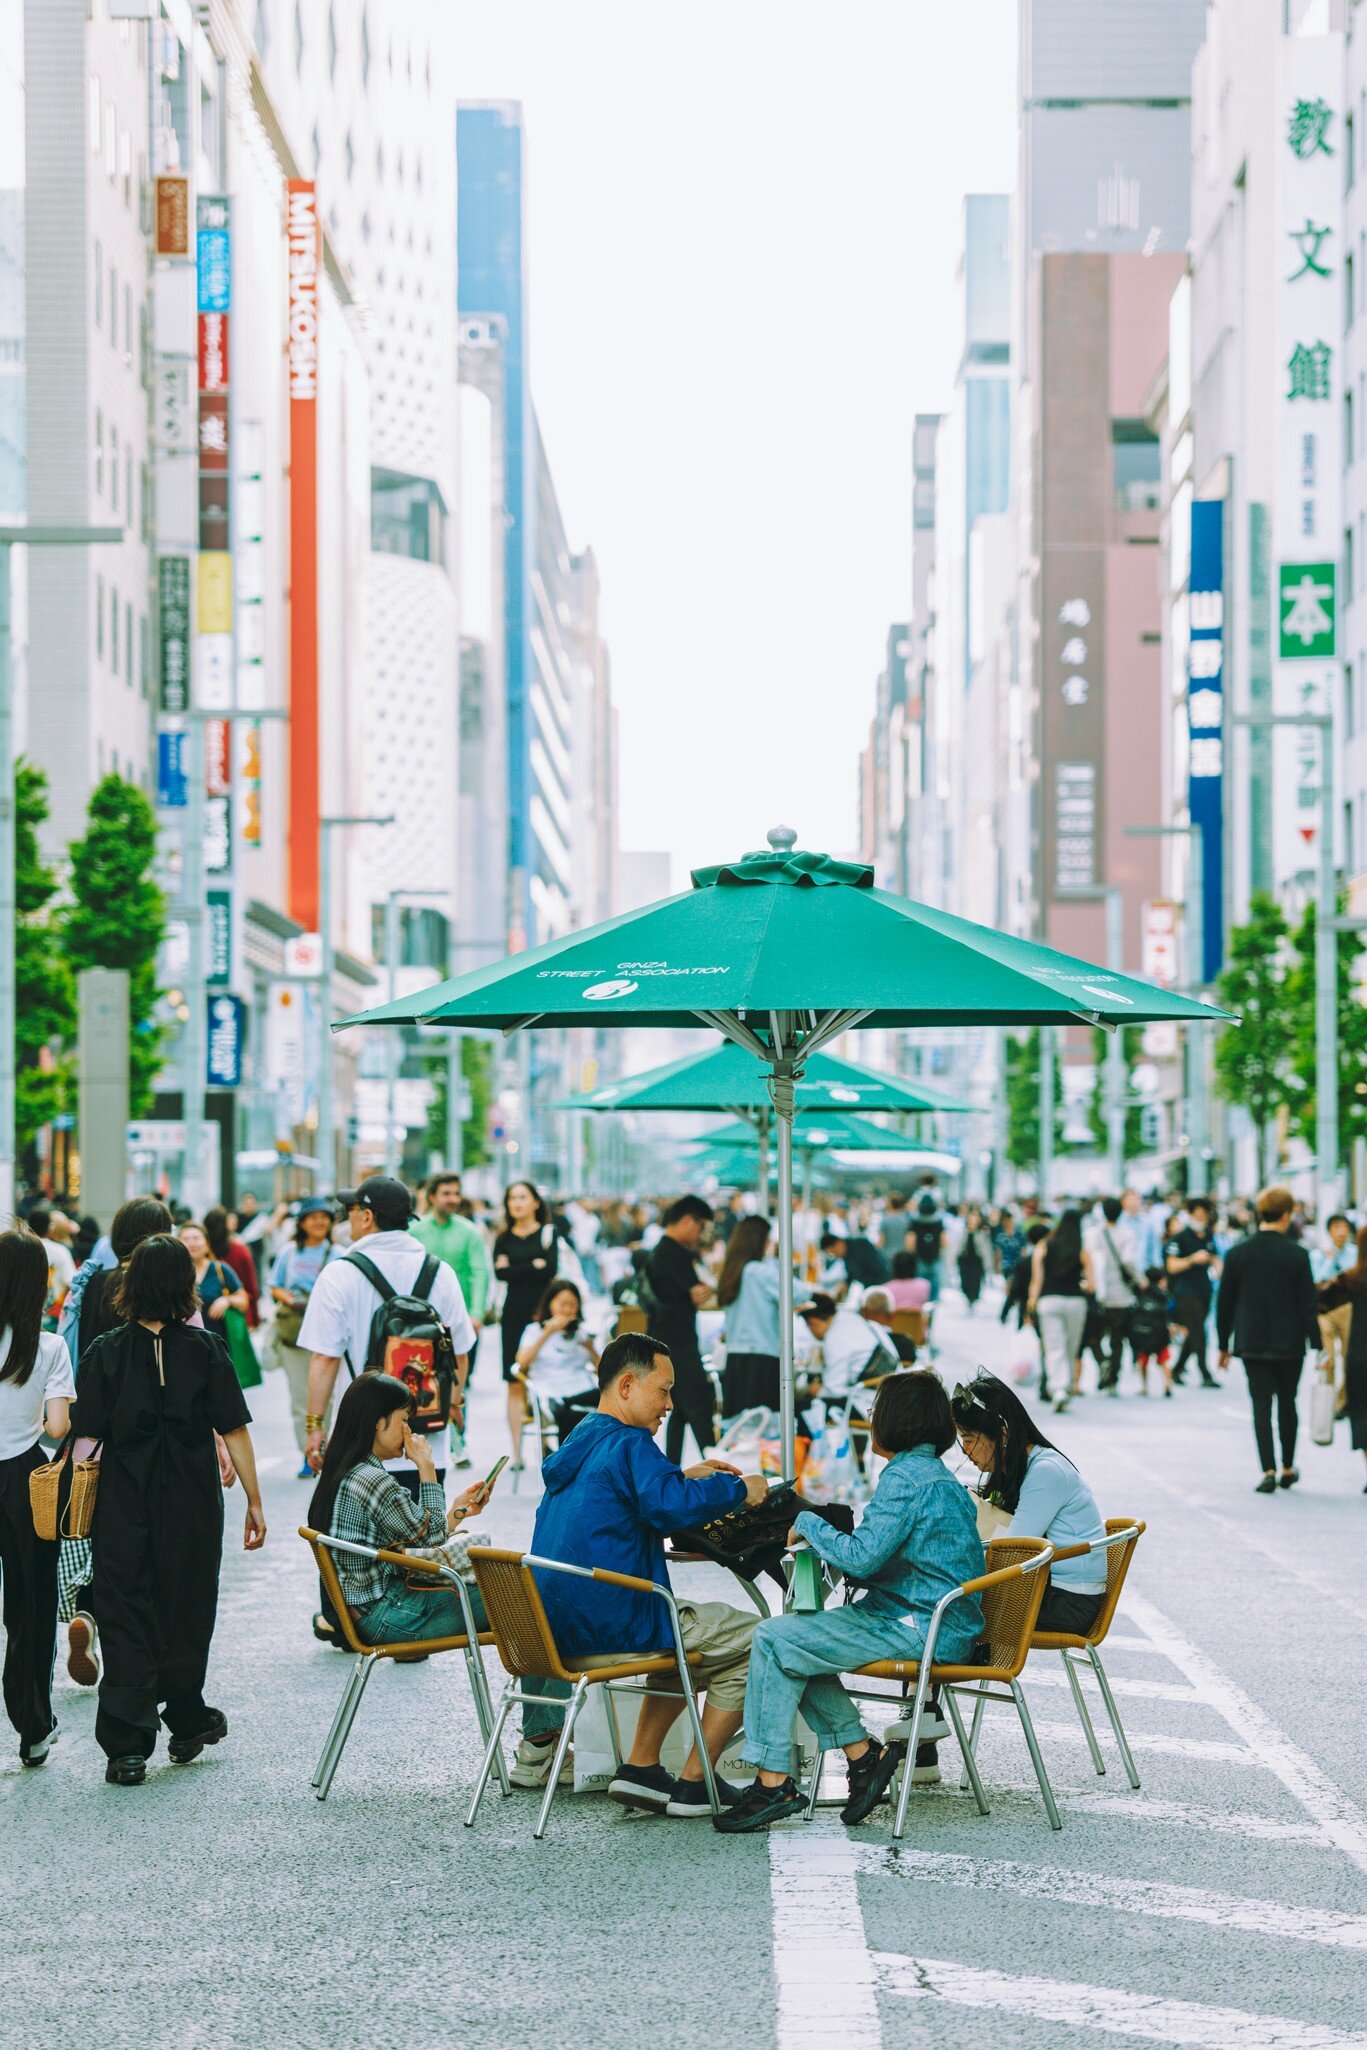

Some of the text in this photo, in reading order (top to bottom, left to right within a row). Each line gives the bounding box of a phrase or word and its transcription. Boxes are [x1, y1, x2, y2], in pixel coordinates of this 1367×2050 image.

[1286, 97, 1333, 400] 教文館
[289, 192, 317, 400] MITSUKOSHI
[1281, 574, 1333, 646] 本
[536, 966, 731, 978] STREET ASSOCIATION
[617, 961, 668, 969] GINZA
